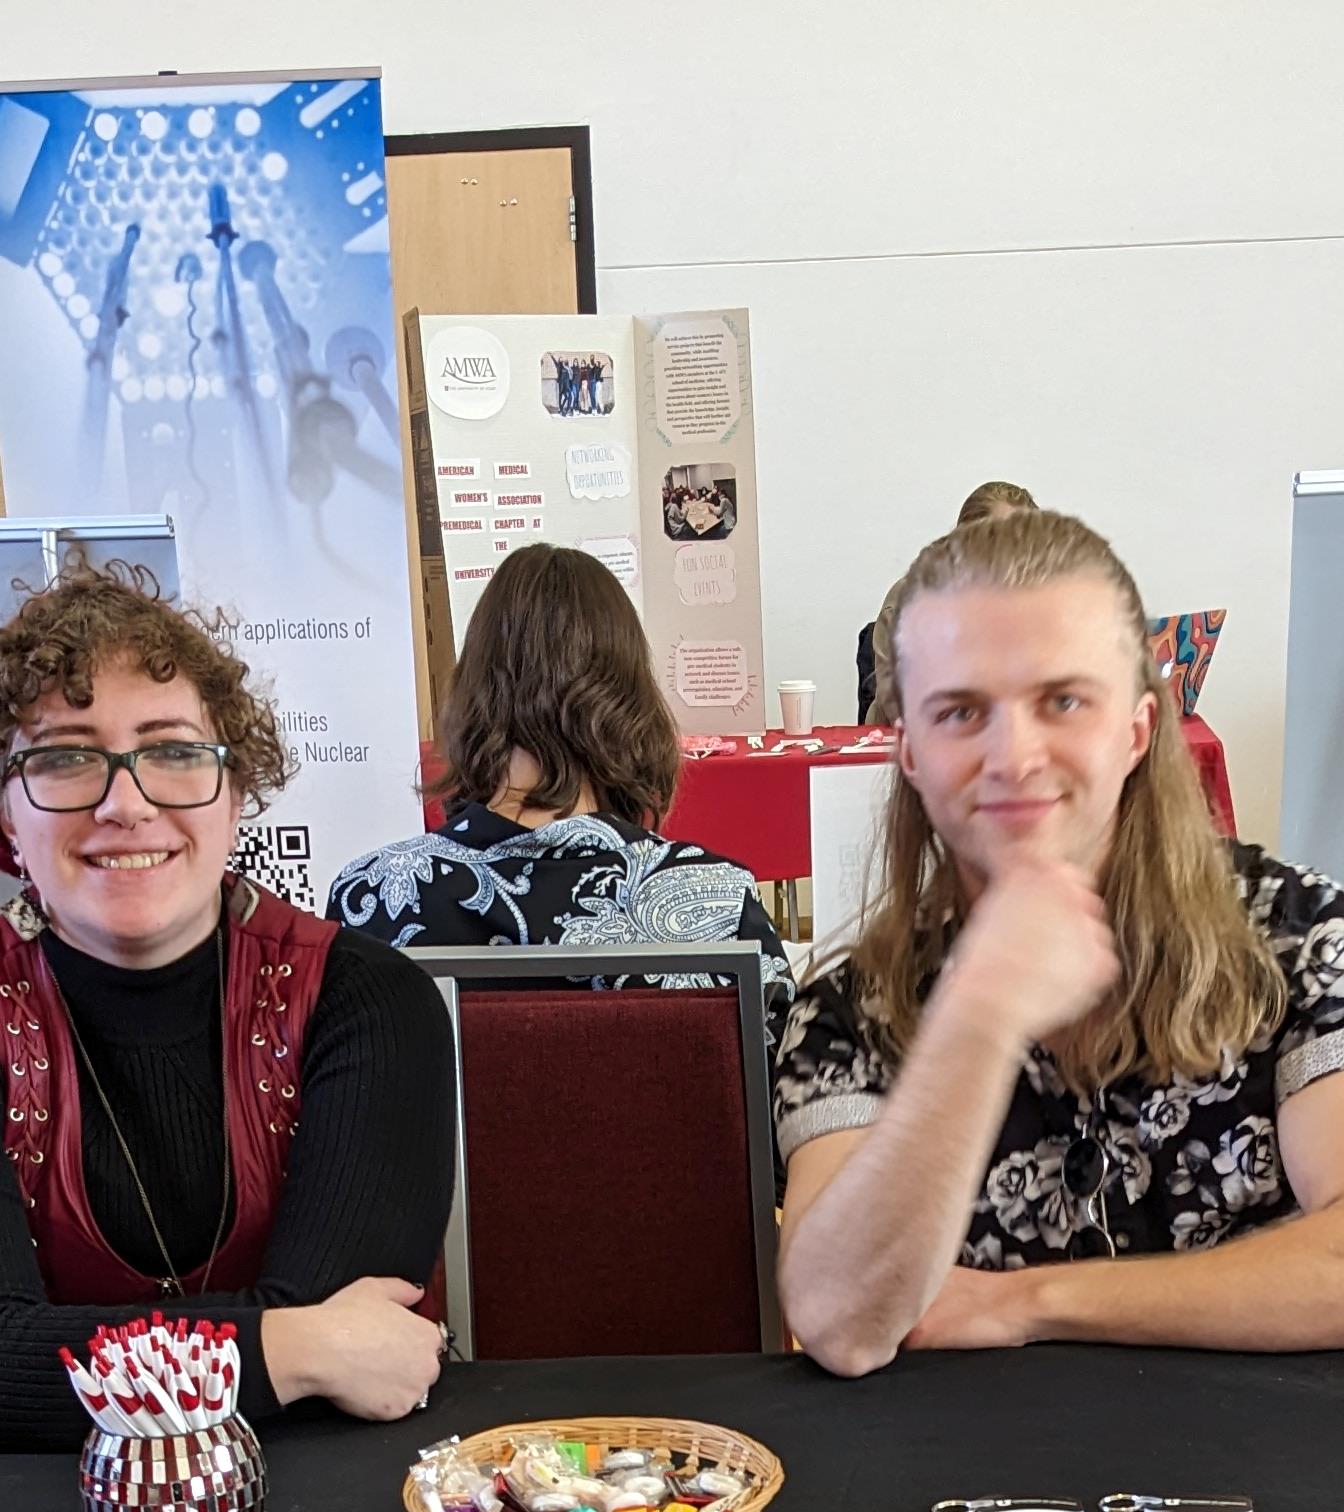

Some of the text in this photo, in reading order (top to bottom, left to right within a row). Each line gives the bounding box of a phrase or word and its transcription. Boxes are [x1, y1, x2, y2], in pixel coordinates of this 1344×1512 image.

[440, 357, 496, 378] AMWA
[437, 465, 528, 476] AMERICAN MEDICAL
[454, 493, 542, 505] WOMEN'S ASSOCIATION
[440, 518, 541, 531] PREMEDICAL CHAPTER AT
[495, 541, 508, 551] THE
[699, 554, 728, 570] SOCIAL
[454, 567, 495, 580] UNIVERSITY
[694, 581, 721, 597] EVENTS
[245, 617, 371, 645] applications of
[306, 742, 370, 763] Nuclear
